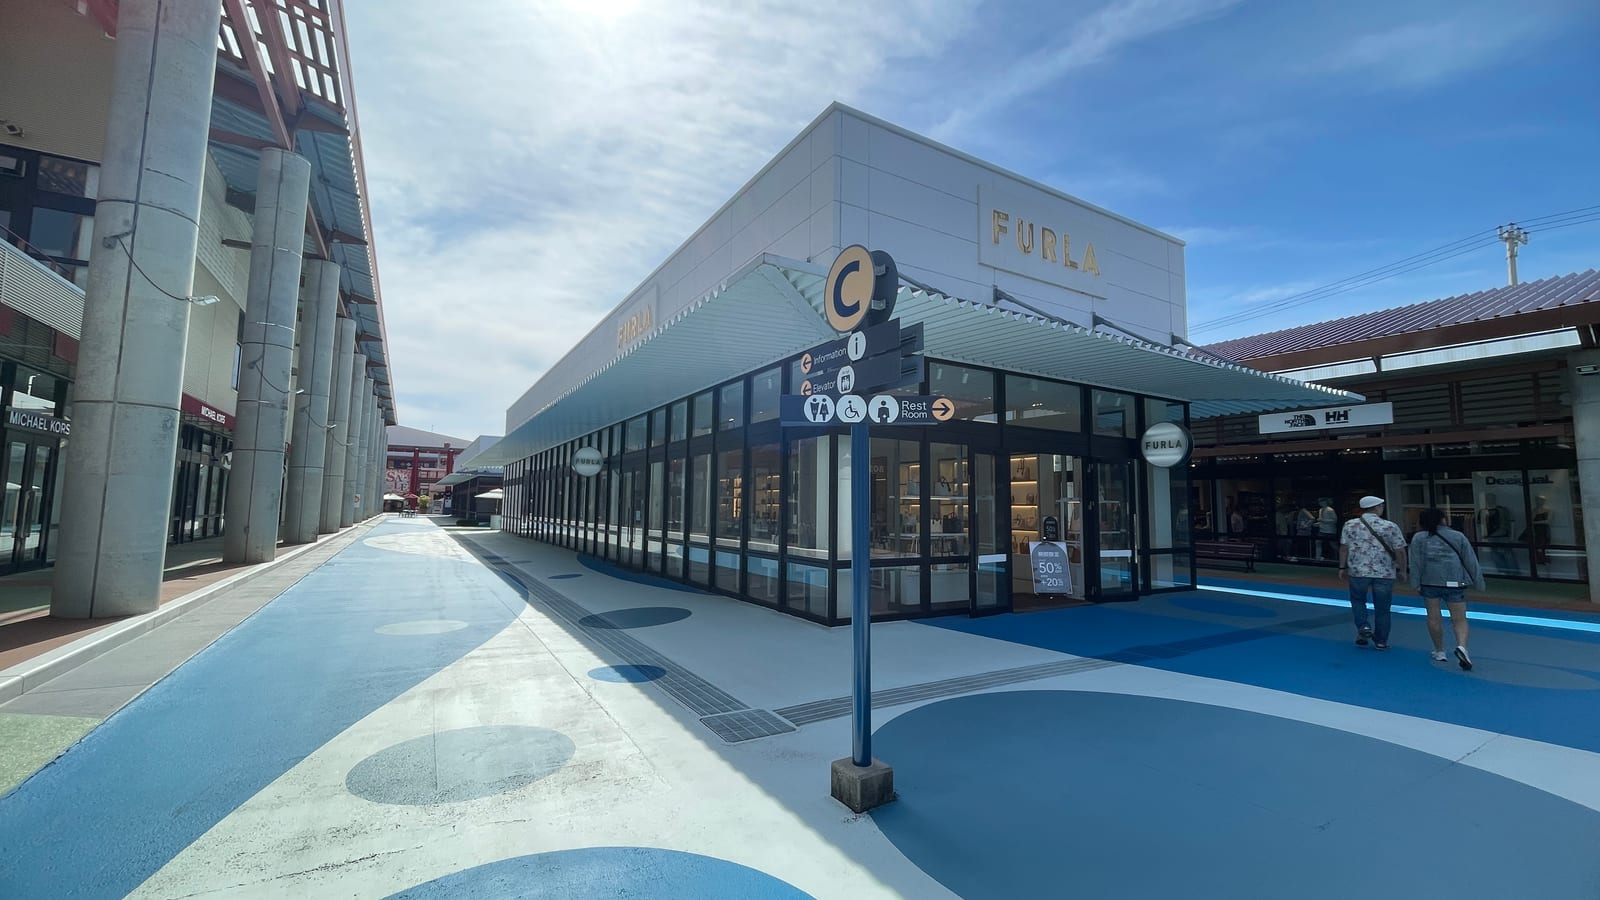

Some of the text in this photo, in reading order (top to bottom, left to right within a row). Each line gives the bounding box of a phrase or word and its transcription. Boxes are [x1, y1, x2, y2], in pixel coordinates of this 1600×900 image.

[992, 209, 1101, 276] FURLA
[833, 260, 860, 318] C
[618, 303, 651, 348] FURLA
[813, 348, 847, 365] Information
[813, 380, 836, 393] Elevator
[902, 400, 926, 410] Rest
[902, 410, 928, 419] Room
[1325, 410, 1349, 422] HH
[9, 410, 71, 435] MICHAEL KORS
[1145, 440, 1182, 450] FURLA
[576, 458, 600, 466] FURLA
